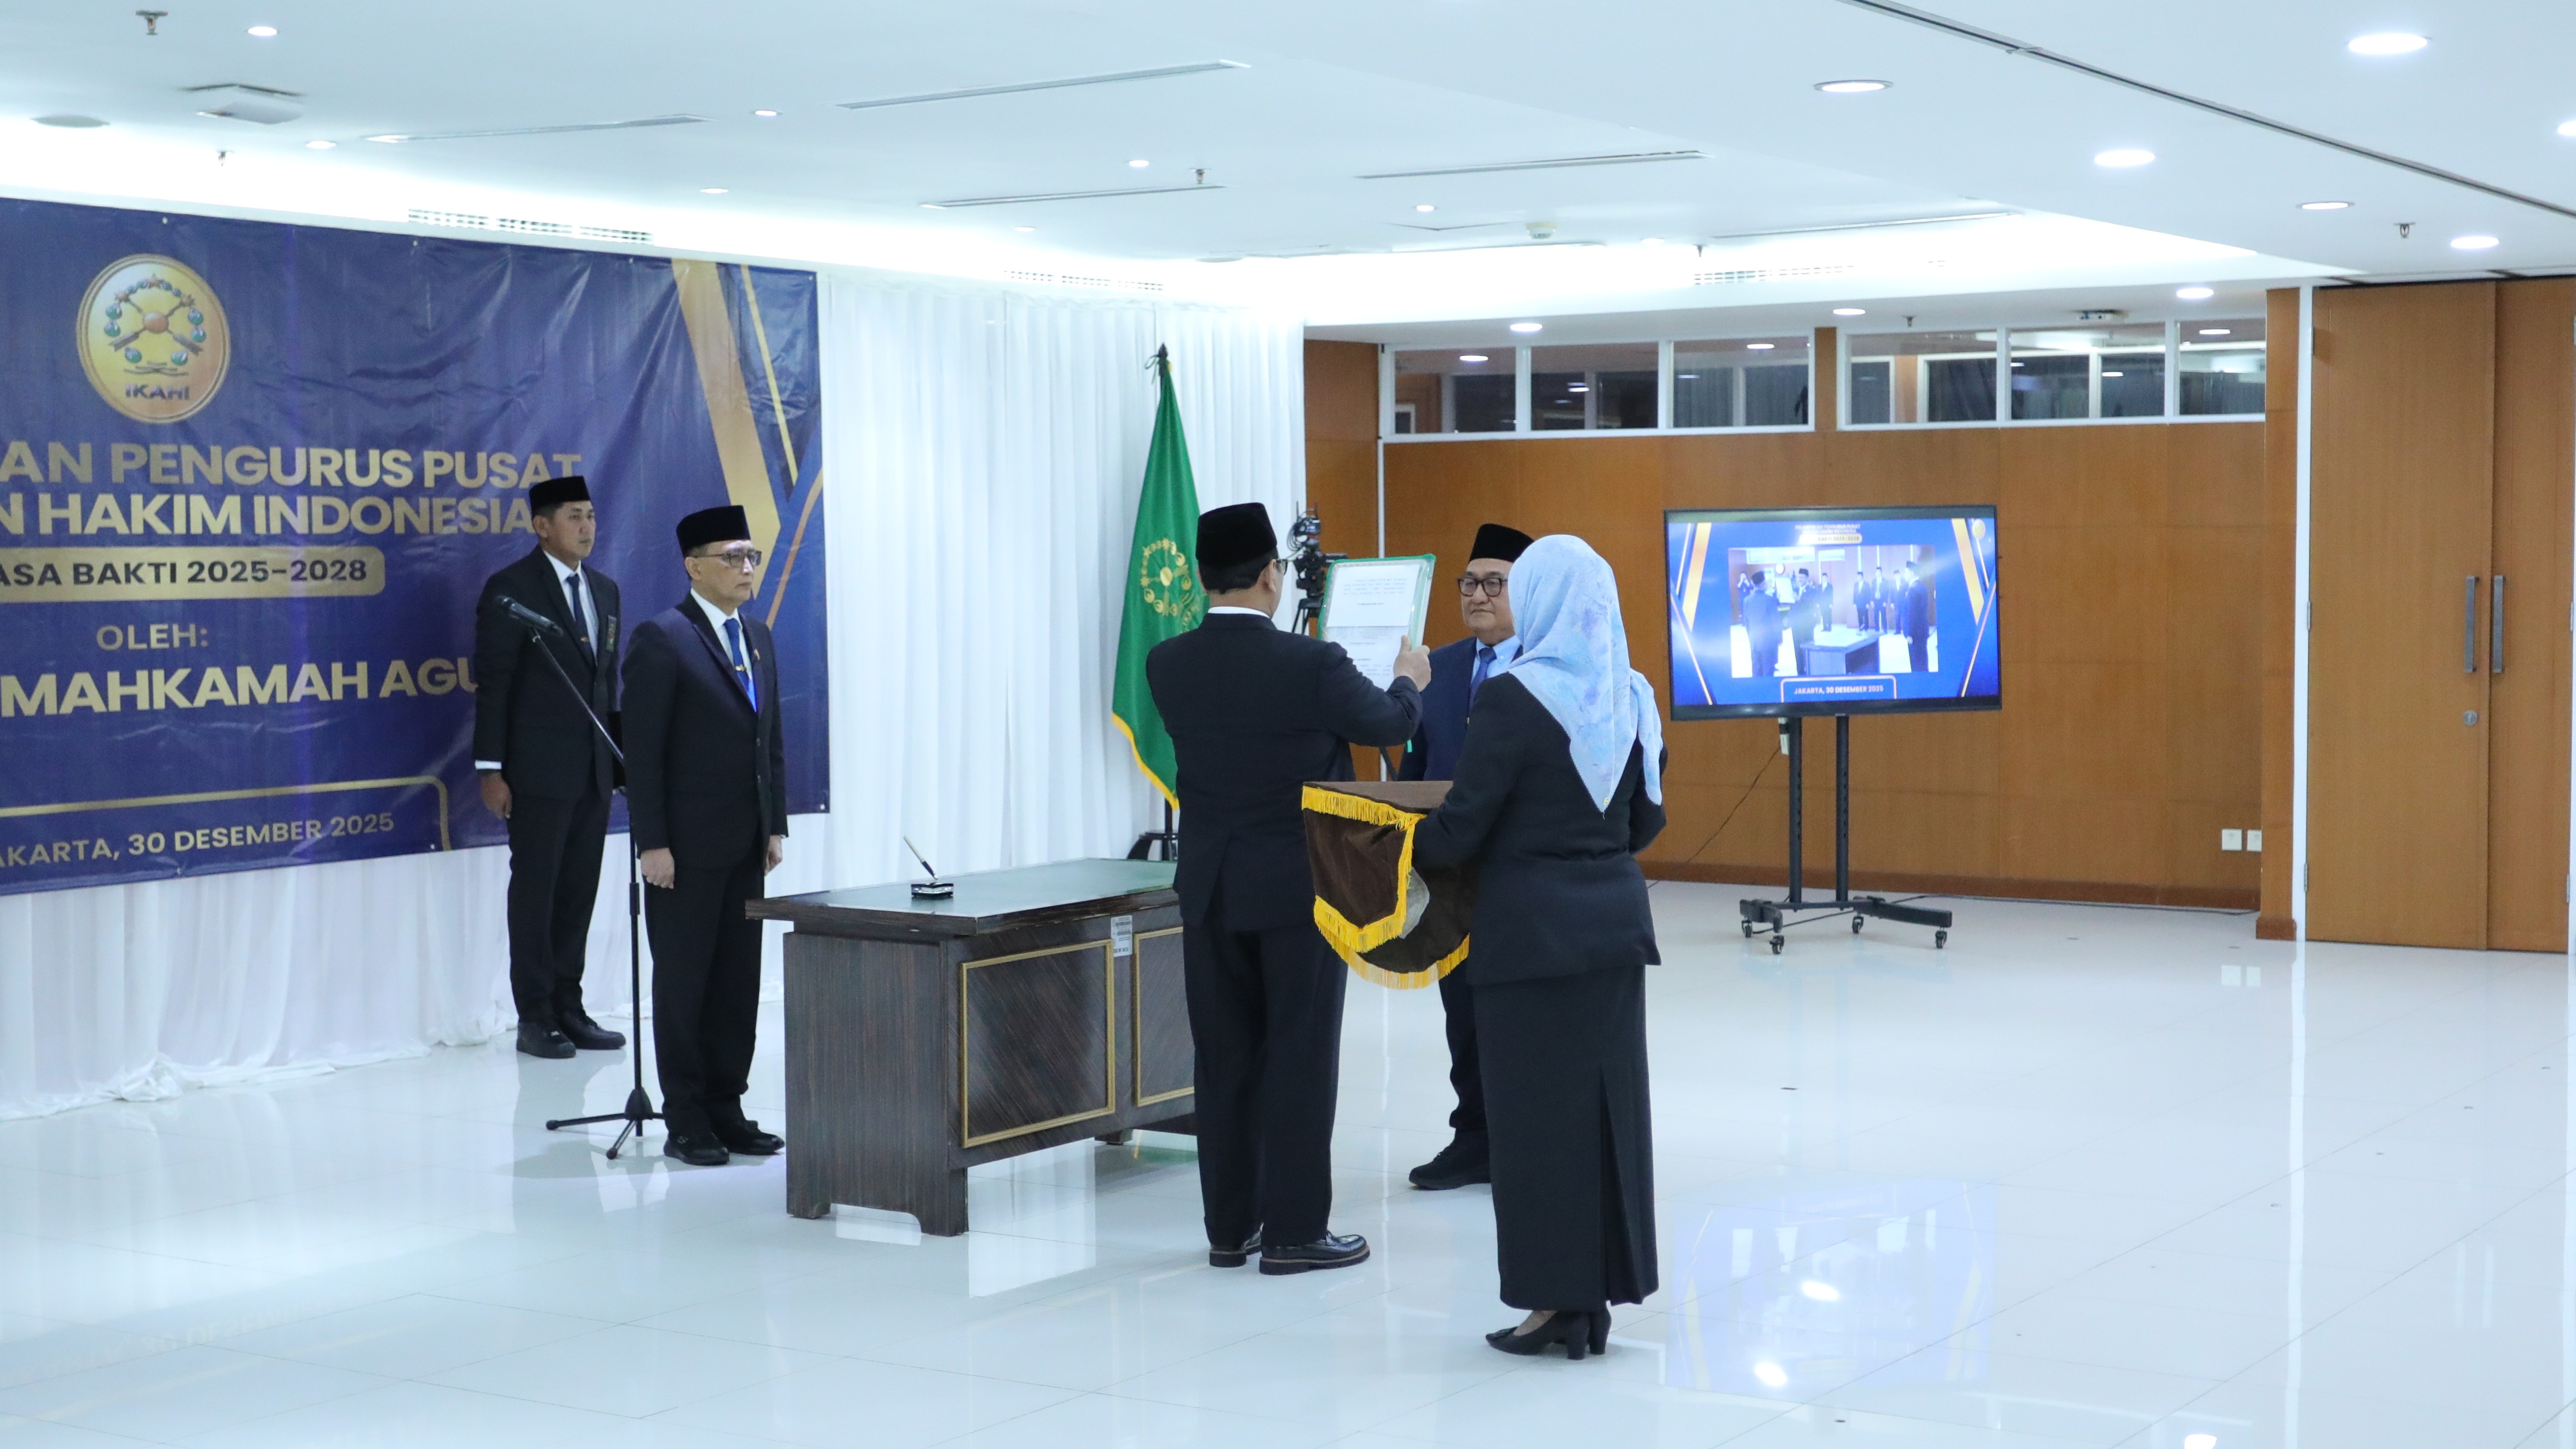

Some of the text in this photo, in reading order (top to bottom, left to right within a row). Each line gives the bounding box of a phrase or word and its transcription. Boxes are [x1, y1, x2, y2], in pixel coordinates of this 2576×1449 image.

[125, 384, 190, 400] IKAHI
[0, 441, 582, 489] AN PENGURUS PUSAT
[38, 493, 241, 535] HAKIM
[254, 495, 535, 535] INDONESIA
[73, 562, 177, 585] BAKTI
[188, 559, 367, 583] 2025-2028
[96, 623, 209, 650] OLEH:
[0, 661, 368, 718] MAHKAMAH
[1835, 685, 1867, 694] DESEMBER
[0, 812, 394, 868] KARTA, 30 DESEMBER 2025
